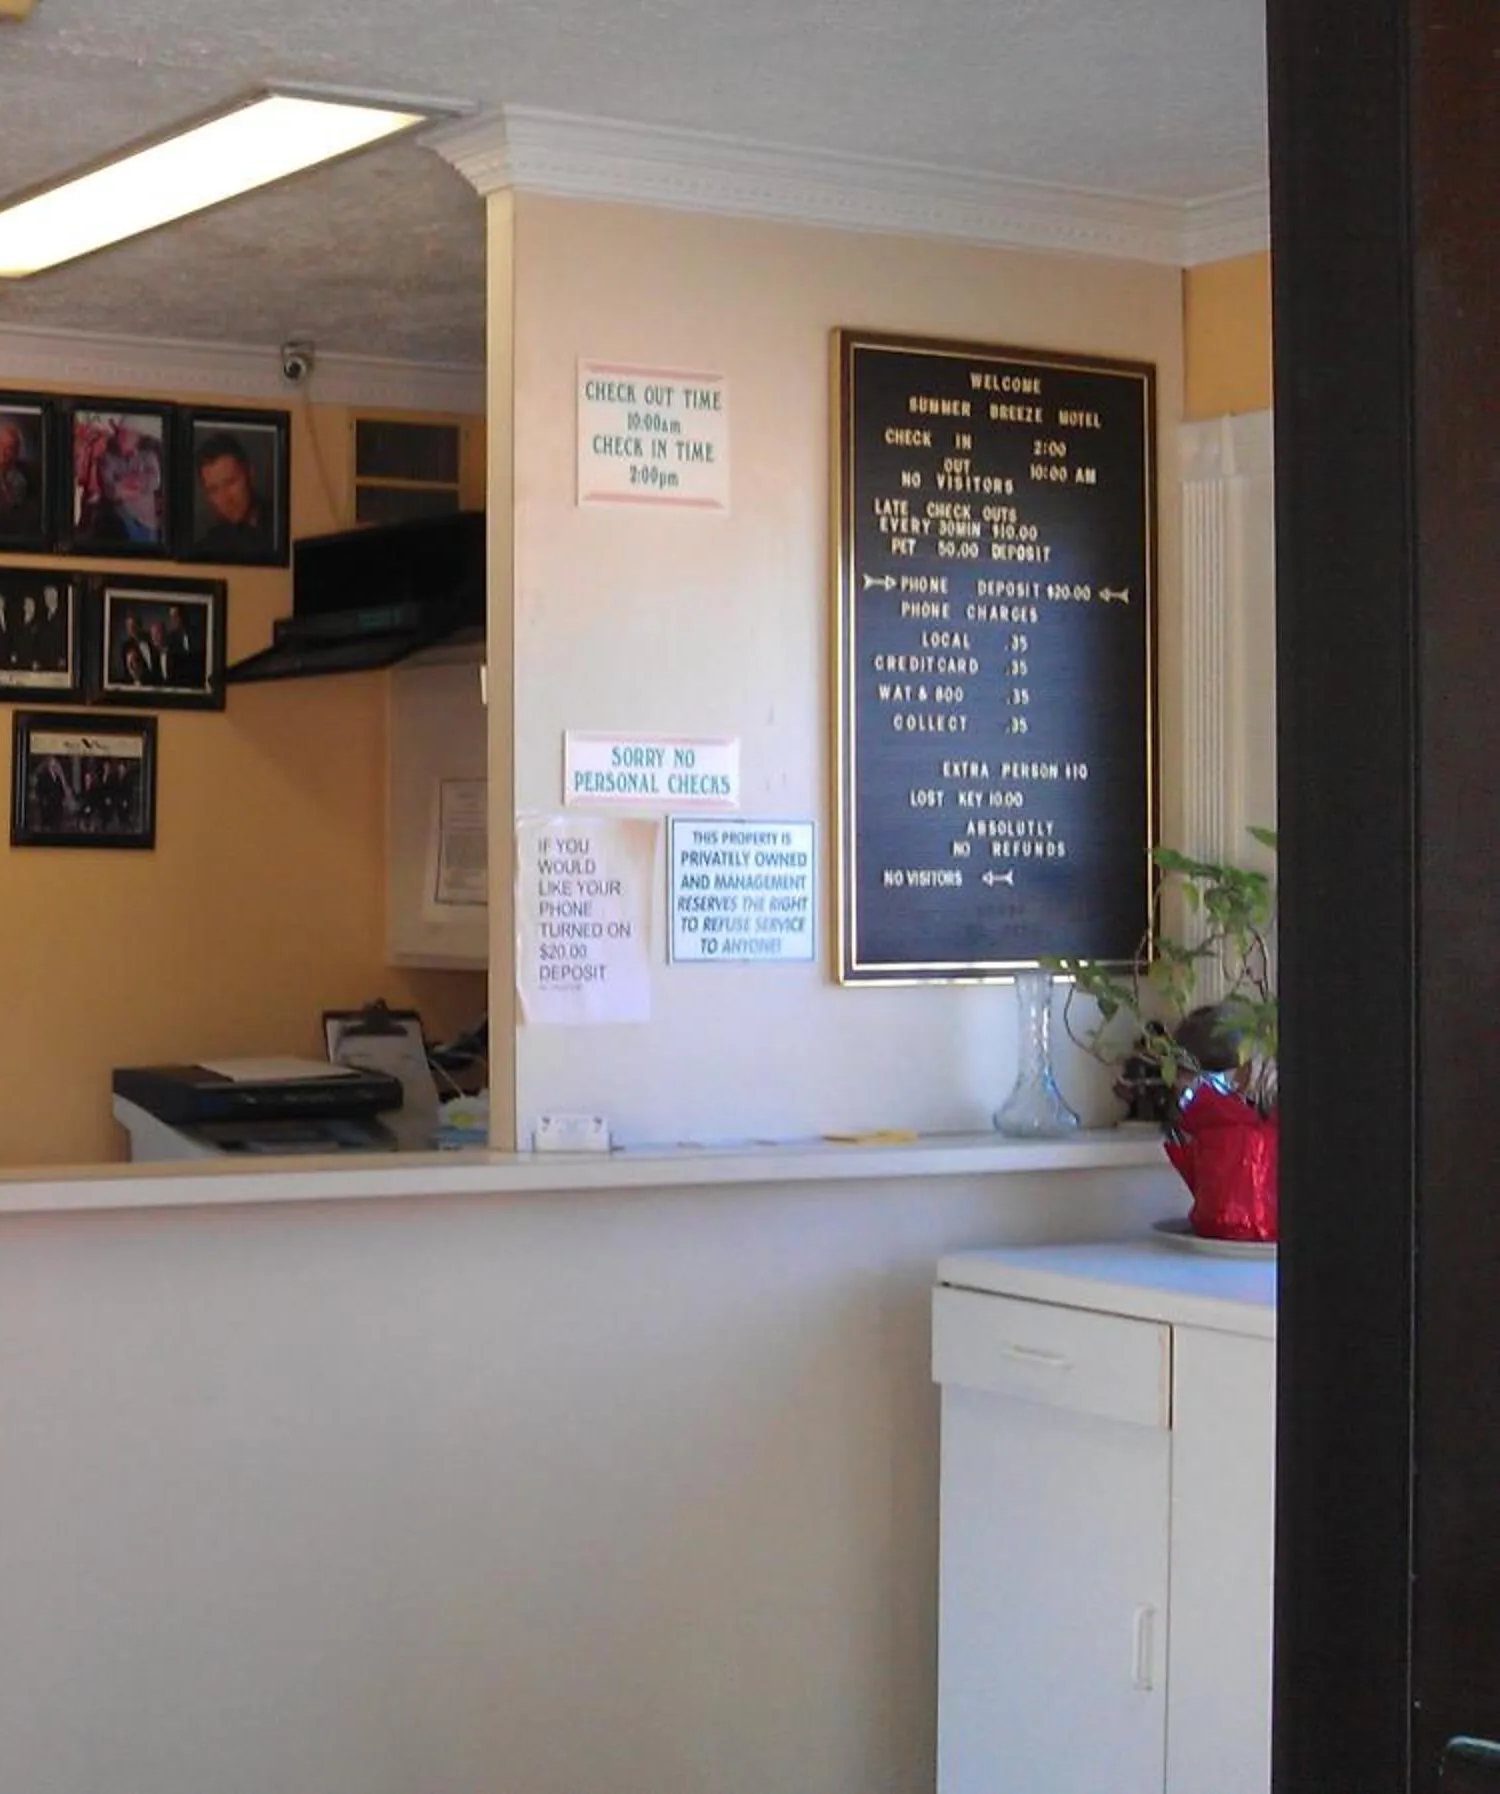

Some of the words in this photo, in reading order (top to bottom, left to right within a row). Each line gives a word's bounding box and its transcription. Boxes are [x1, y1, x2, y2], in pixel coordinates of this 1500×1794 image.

[970, 372, 1040, 394] WELCOME
[585, 381, 636, 402] CHECK
[644, 385, 673, 407] OUT
[684, 389, 721, 410] TIME
[909, 396, 971, 417] SUMMER
[990, 403, 1043, 423] BREEZE
[1059, 410, 1101, 428] MOTEL
[593, 435, 643, 457] CHECK
[652, 439, 667, 458] IN
[676, 442, 714, 462] TIME
[885, 428, 932, 447] CHECK
[955, 433, 972, 450] IN
[1034, 439, 1066, 457] 2:00
[944, 458, 971, 473] OUT
[1030, 463, 1067, 481] 10:00
[1075, 468, 1096, 484] AM
[902, 471, 921, 489] NO
[937, 474, 1014, 494] VISITORS
[874, 499, 909, 516] LATE
[926, 501, 971, 520] CHECK
[982, 506, 1017, 523] OUTS
[880, 517, 930, 534] EVERY
[938, 519, 981, 538] 30MIN
[991, 521, 1038, 541] $10.00
[892, 538, 916, 556] PET
[938, 542, 979, 558] 50.00
[992, 545, 1051, 562] DEPOSIT
[900, 575, 948, 594] PHONE
[977, 579, 1040, 598] DEPOSIT
[900, 601, 950, 619] PHONE
[967, 602, 1038, 623] CHARGES
[921, 632, 971, 650] LOCAL
[935, 687, 964, 702] 800
[893, 713, 967, 732] COLLECT
[612, 747, 665, 768] SORRY
[674, 749, 695, 768] NO
[943, 761, 989, 779] EXTRA
[1001, 762, 1058, 780] PERSON
[574, 772, 659, 792] PERSONAL
[667, 775, 731, 794] CHECKS
[910, 789, 944, 808] LOST
[958, 790, 985, 808] KEY
[967, 819, 1054, 837] ABSOLUTLY
[538, 838, 550, 852] IF
[555, 839, 589, 854] YOU
[692, 831, 718, 844] THIS
[722, 831, 777, 845] PROPERTY
[782, 832, 791, 844] IS
[953, 840, 970, 856] NO
[992, 840, 1066, 857] REFUNDS
[538, 859, 596, 874] WOULD
[681, 851, 749, 866] PRIVATELY
[754, 852, 808, 866] OWNED
[681, 874, 710, 890] AND
[714, 874, 807, 890] MANAGEMENT
[884, 870, 904, 887] NO
[906, 869, 962, 887] VISITORS
[538, 880, 572, 896] LIKE
[576, 881, 621, 896] YOUR
[539, 901, 592, 917] PHONE
[677, 896, 736, 911] RESERVES
[742, 897, 765, 911] THE
[769, 897, 808, 912] RIGHT
[539, 922, 603, 938] TURNED
[607, 923, 631, 938] ON
[681, 917, 699, 933] TO
[703, 917, 751, 932] REFUSE
[754, 917, 804, 933] SERVICE
[539, 944, 587, 961] $20.00
[700, 938, 718, 954] TO
[539, 964, 606, 982] DEPOSIT
